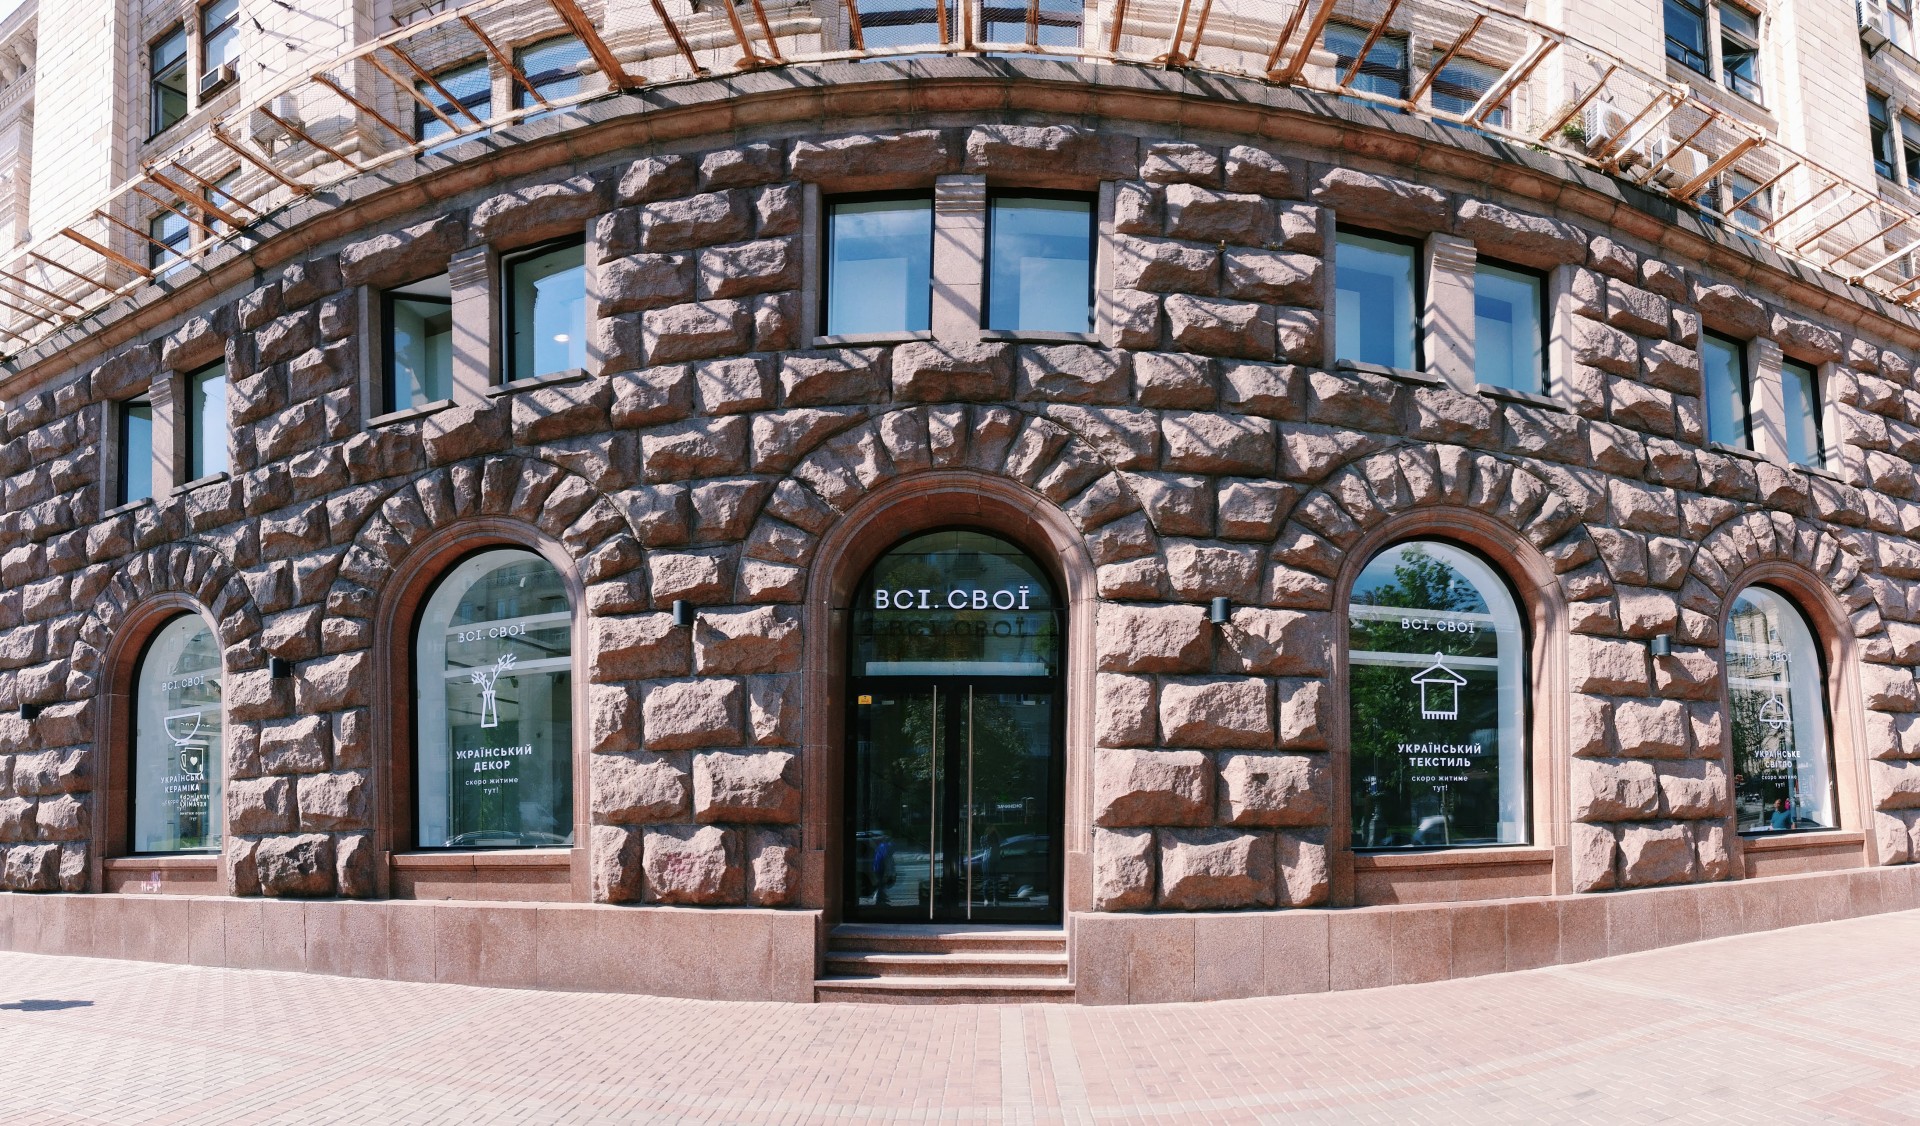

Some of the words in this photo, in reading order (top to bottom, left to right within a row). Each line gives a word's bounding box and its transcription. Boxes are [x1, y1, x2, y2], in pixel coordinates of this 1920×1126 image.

[875, 589, 939, 609] ВСІ.
[947, 586, 1030, 610] СВОЇ
[458, 630, 486, 643] ВСІ.
[488, 621, 526, 639] СВОЇ
[1401, 618, 1434, 631] ВСІ.
[1436, 620, 1475, 634] СВОЇ
[181, 673, 205, 688] СВОЇ
[456, 743, 532, 760] УКРАЇНСЬКИЙ
[1397, 741, 1482, 755] УКРАЇНСЬКИЙ
[473, 760, 511, 773] ДЕКОР
[1409, 757, 1471, 767] ТЕКСТИЛЬ
[160, 773, 204, 784] УКРАЇНСЬКА
[489, 777, 519, 785] житиме
[1411, 775, 1436, 783] скоро
[164, 783, 200, 794] КЕРАМІКА
[483, 787, 499, 796] тут!
[1432, 784, 1448, 792] тут!
